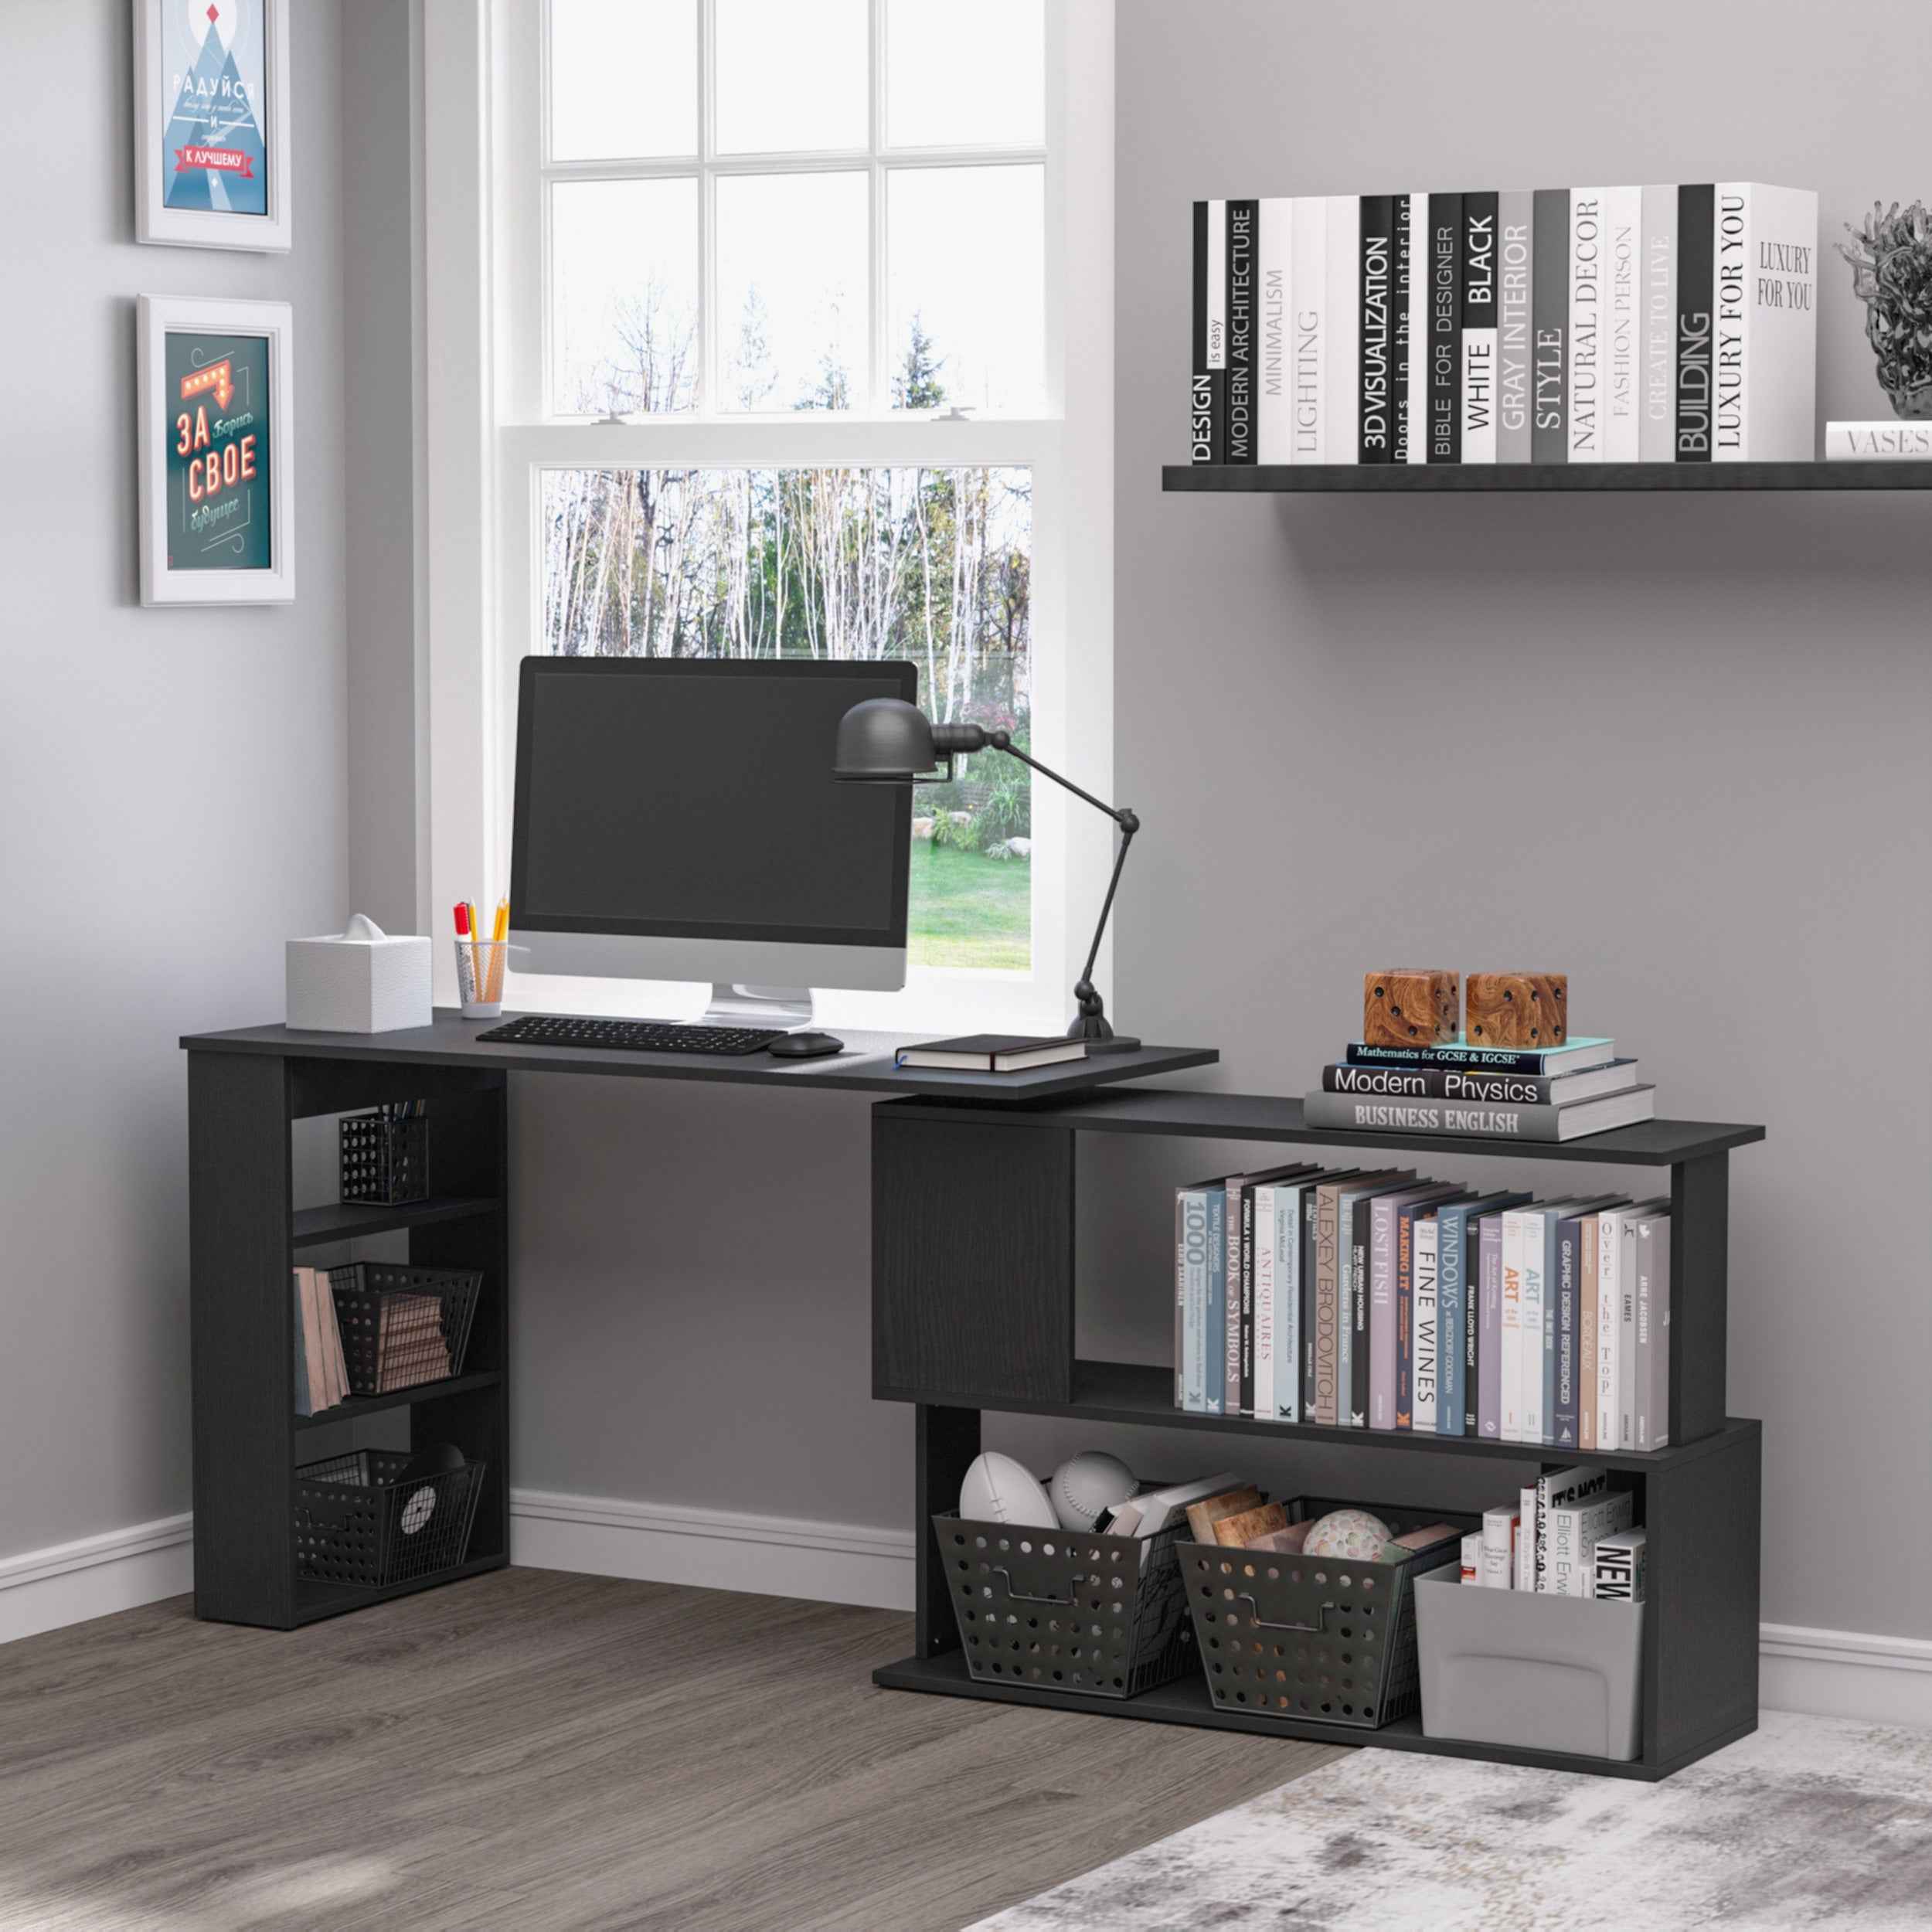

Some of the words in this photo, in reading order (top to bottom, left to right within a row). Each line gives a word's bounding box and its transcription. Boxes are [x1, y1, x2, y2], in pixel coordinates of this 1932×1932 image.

[210, 115, 217, 128] И
[185, 149, 192, 162] К
[194, 150, 242, 167] ЛУЧШЕМУ
[1396, 200, 1410, 294] interior
[1721, 195, 1745, 253] YOU
[1468, 215, 1492, 303] BLACK
[1575, 199, 1599, 304] DECOR
[1614, 226, 1632, 311] PERSON
[1650, 235, 1669, 287] LIVE
[1760, 241, 1811, 274] LUXURY
[1232, 209, 1250, 362] ARCHITECTURE
[1437, 226, 1453, 332] DESIGNER
[1504, 225, 1528, 349] INTERIOR
[1719, 263, 1743, 321] FOR
[1757, 277, 1783, 308] FOR
[1786, 281, 1812, 311] YOU
[1266, 269, 1283, 396] MINIMALISM
[1365, 236, 1388, 412] VISUALIZATION
[1396, 311, 1410, 345] the
[1650, 294, 1668, 324] TO
[1209, 352, 1221, 363] is
[1211, 319, 1223, 351] easy
[1298, 311, 1318, 452] LIGHTING
[1435, 344, 1452, 386] FOR
[1468, 344, 1490, 430] WHITE
[1536, 328, 1562, 429] STYLE
[1573, 313, 1596, 451] NATURAL
[1613, 318, 1631, 417] FASHION
[1649, 327, 1668, 420] CREATE
[1679, 312, 1710, 452] BUILDING
[1718, 332, 1741, 448] LUXURY
[1192, 374, 1211, 461] DESIGN
[1231, 368, 1248, 457] MODERN
[1503, 358, 1526, 430] GRAY
[177, 406, 210, 457] ЗА
[212, 412, 254, 439] Борись
[1365, 414, 1386, 448] 3D
[1435, 398, 1451, 454] BIBLE
[1845, 429, 1930, 454] VASES
[189, 434, 257, 504] СВОЕ
[190, 498, 241, 533] будущее
[1356, 1046, 1419, 1060] Mathematics
[1421, 1049, 1435, 1060] for
[1437, 1050, 1468, 1063] GCSE
[1469, 1052, 1479, 1063] &
[1335, 1068, 1427, 1095] Modern
[1444, 1074, 1539, 1103] Physics
[1355, 1105, 1440, 1129] BUSINESS
[1444, 1110, 1519, 1133] ENGLISH
[1186, 1201, 1206, 1265] 1000
[1243, 1199, 1251, 1235] FORMULA
[1318, 1192, 1335, 1272] ALEXEY
[1373, 1205, 1389, 1257] LOST
[1227, 1235, 1240, 1284] BOOK
[1243, 1242, 1251, 1268] WORLD
[1399, 1216, 1410, 1273] MAKING
[1441, 1216, 1460, 1308] WINDOWS
[1561, 1240, 1572, 1289] GRAPHIC
[1243, 1270, 1251, 1314] CHAMPIONS
[1260, 1247, 1272, 1361] ANTIQUAIRES
[1342, 1264, 1352, 1304] Gardens
[1373, 1260, 1389, 1305] FISH
[1399, 1275, 1410, 1291] IT
[1419, 1251, 1436, 1308] FINE
[1468, 1285, 1476, 1311] FRANK
[1504, 1267, 1520, 1304] ART
[1525, 1268, 1541, 1305] ART
[1342, 1311, 1352, 1322] in
[1467, 1311, 1475, 1335] LLOYD
[1561, 1291, 1572, 1331] DESIGN
[1624, 1294, 1632, 1323] EAMES
[1638, 1300, 1648, 1344] JACOBSEN
[1226, 1300, 1240, 1383] SYMBOLS
[1317, 1278, 1335, 1410] BRODOVITCH
[1342, 1326, 1352, 1364] France
[1417, 1319, 1435, 1403] WINES
[1467, 1336, 1475, 1367] WRIGHT
[1560, 1334, 1571, 1405] REFERENCED
[1556, 1514, 1571, 1556] Elliott
